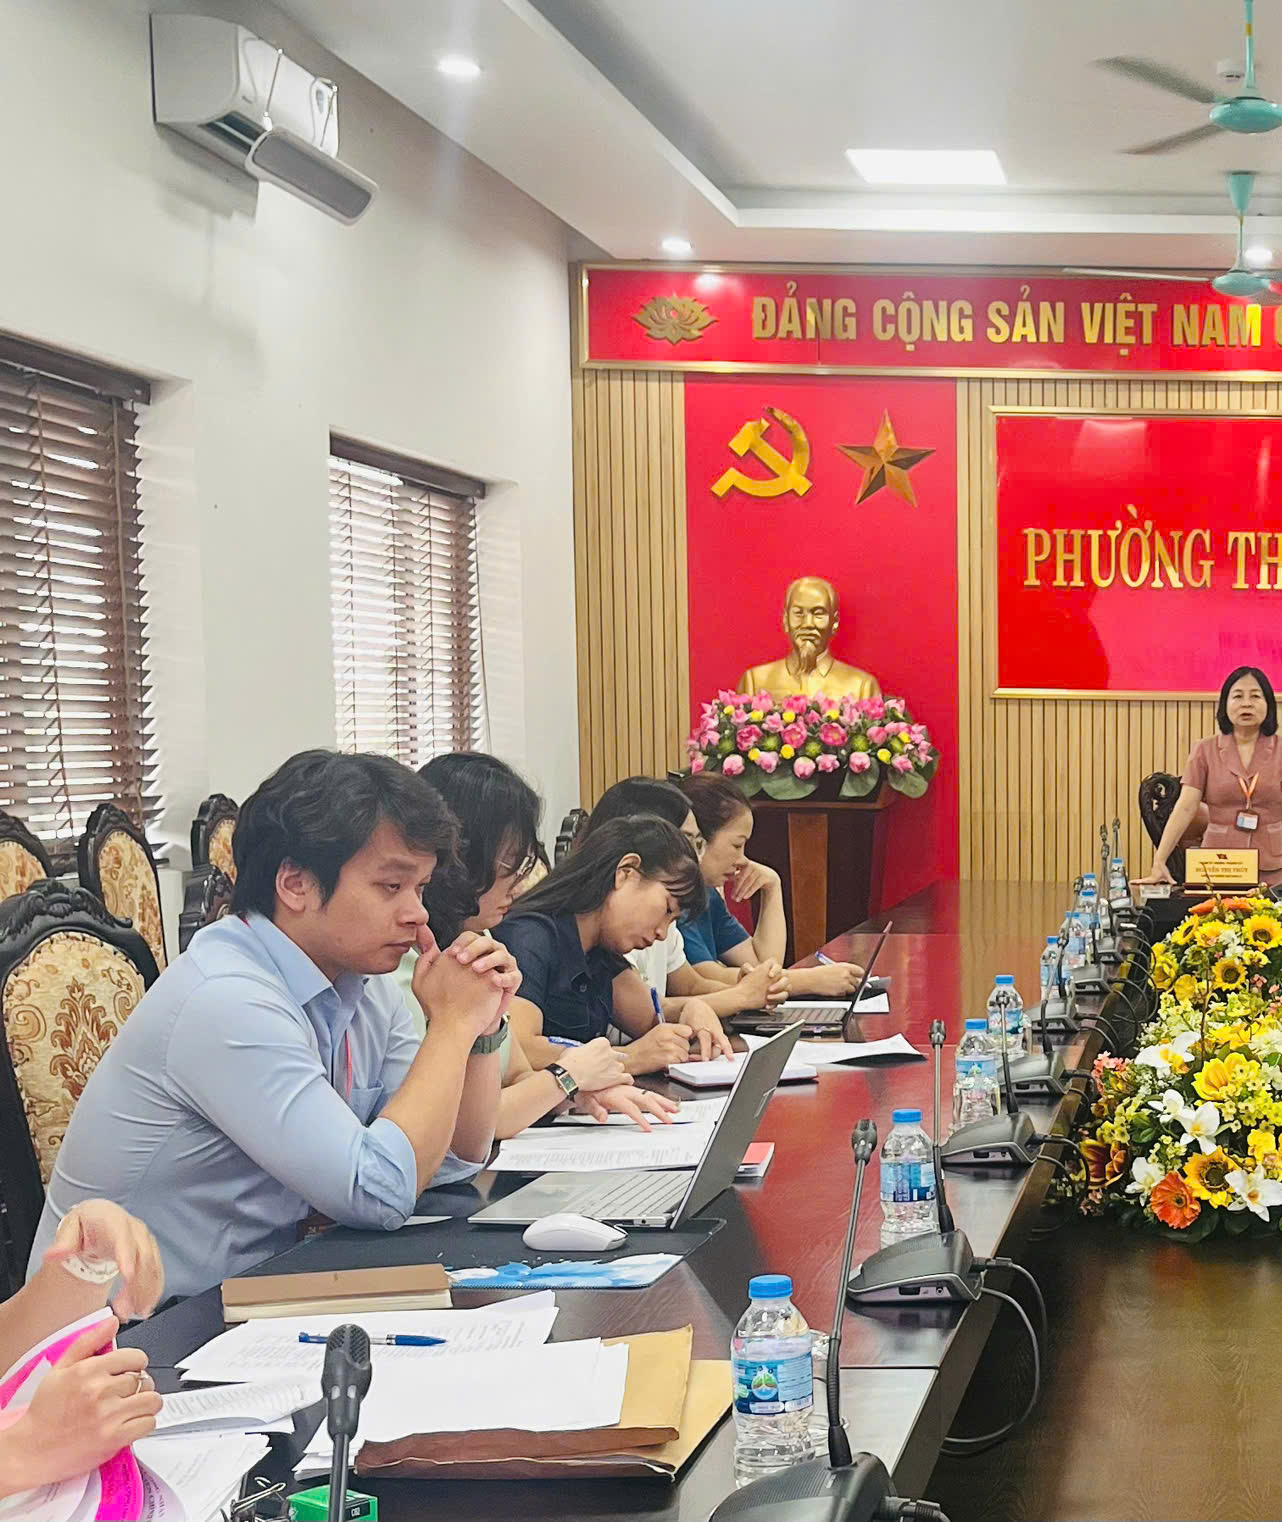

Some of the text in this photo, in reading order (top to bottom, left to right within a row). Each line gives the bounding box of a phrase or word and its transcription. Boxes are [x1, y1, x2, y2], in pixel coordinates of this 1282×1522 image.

[752, 281, 857, 340] ĐẢNG
[873, 291, 973, 351] CỘNG
[986, 285, 1064, 345] SẢN
[1081, 293, 1158, 356] VIỆT
[1172, 302, 1262, 349] NAM
[1023, 504, 1215, 590] PHƯỜNG
